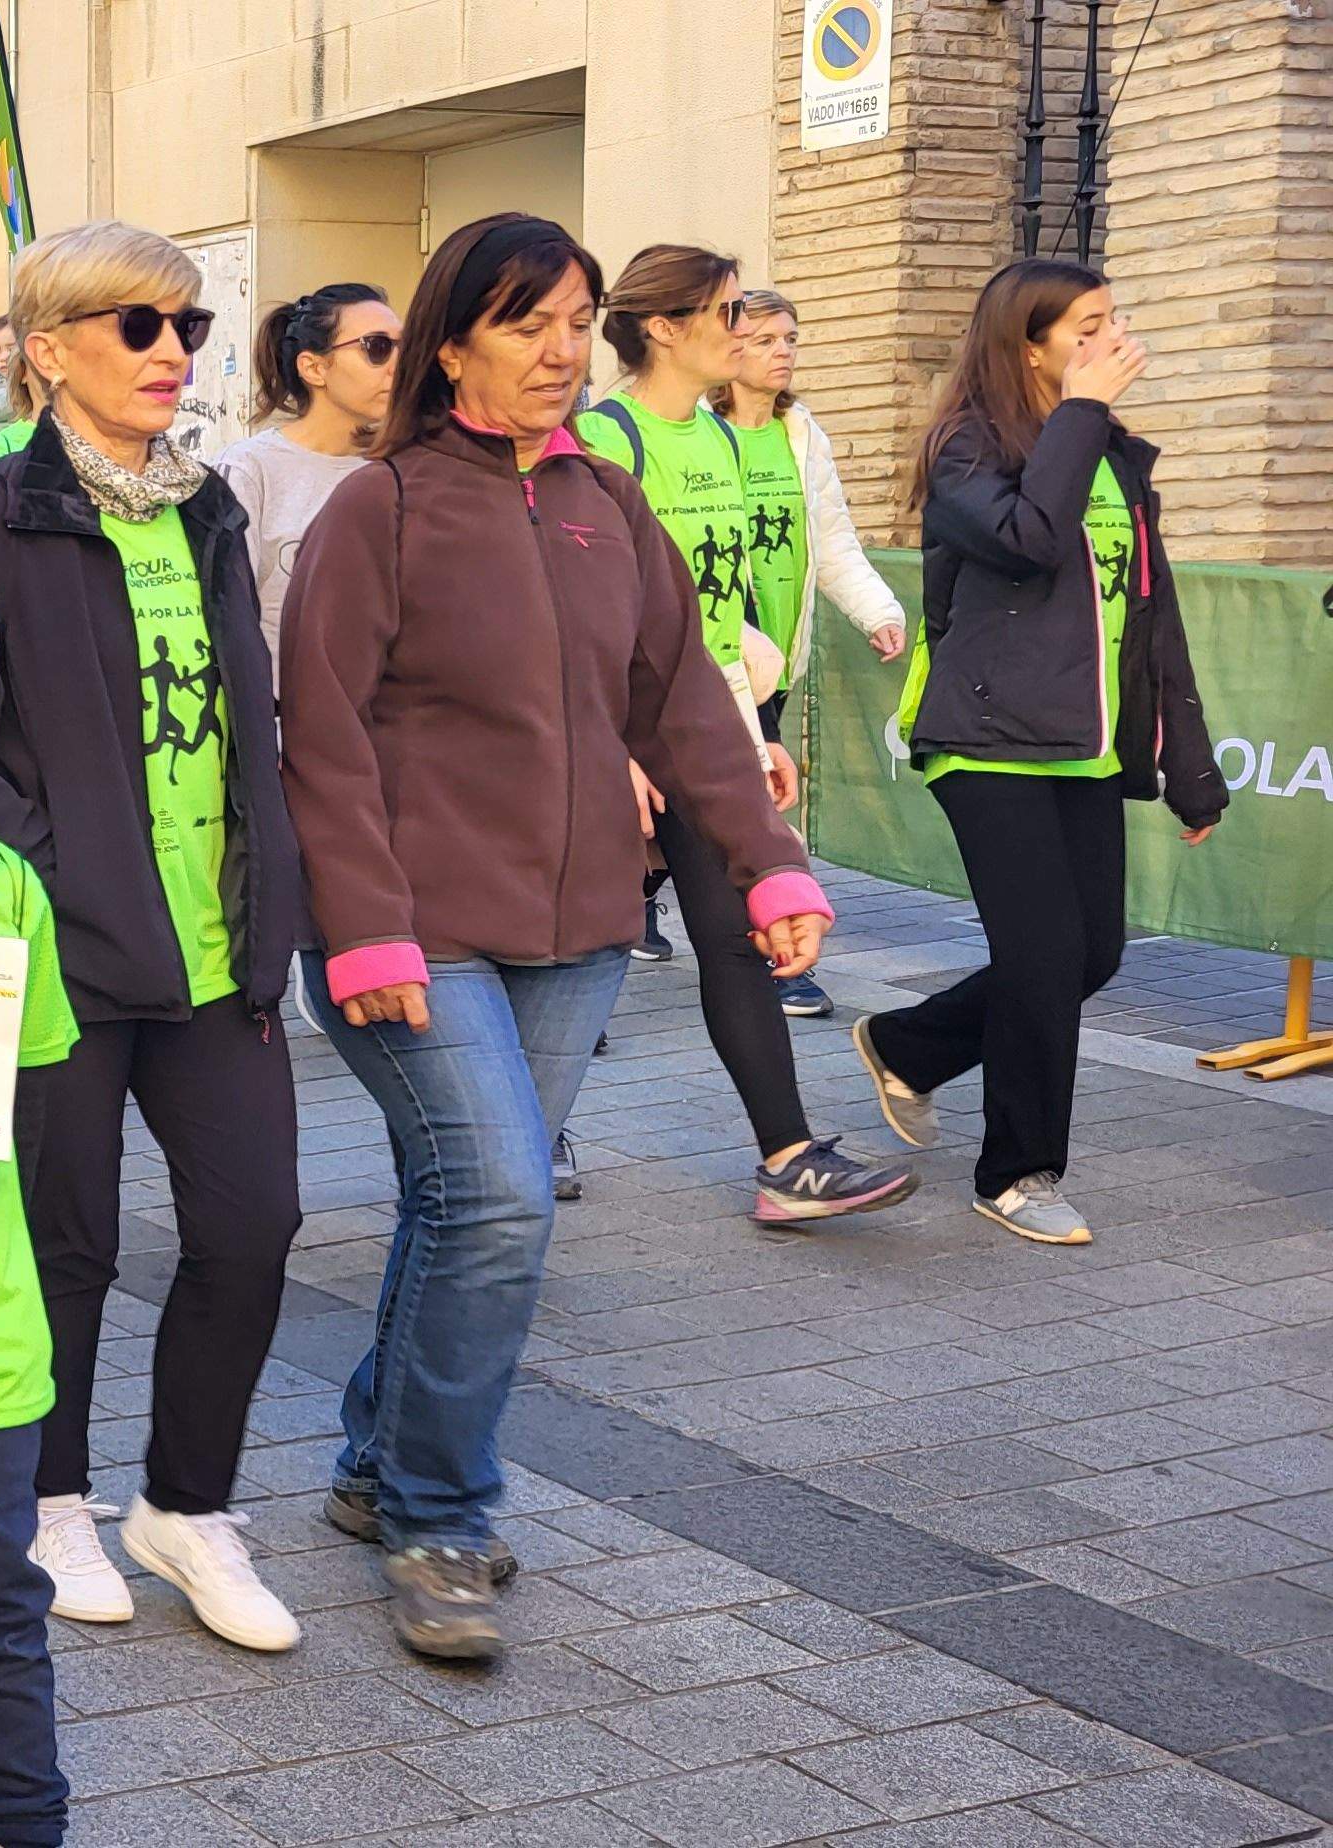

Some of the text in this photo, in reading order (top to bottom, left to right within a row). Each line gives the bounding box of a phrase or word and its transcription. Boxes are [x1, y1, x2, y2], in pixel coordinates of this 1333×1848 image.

[808, 104, 835, 122] VADO
[870, 121, 877, 132] 6
[657, 508, 669, 516] EN
[701, 505, 715, 513] POR
[717, 504, 727, 512] LA
[176, 606, 193, 617] LA
